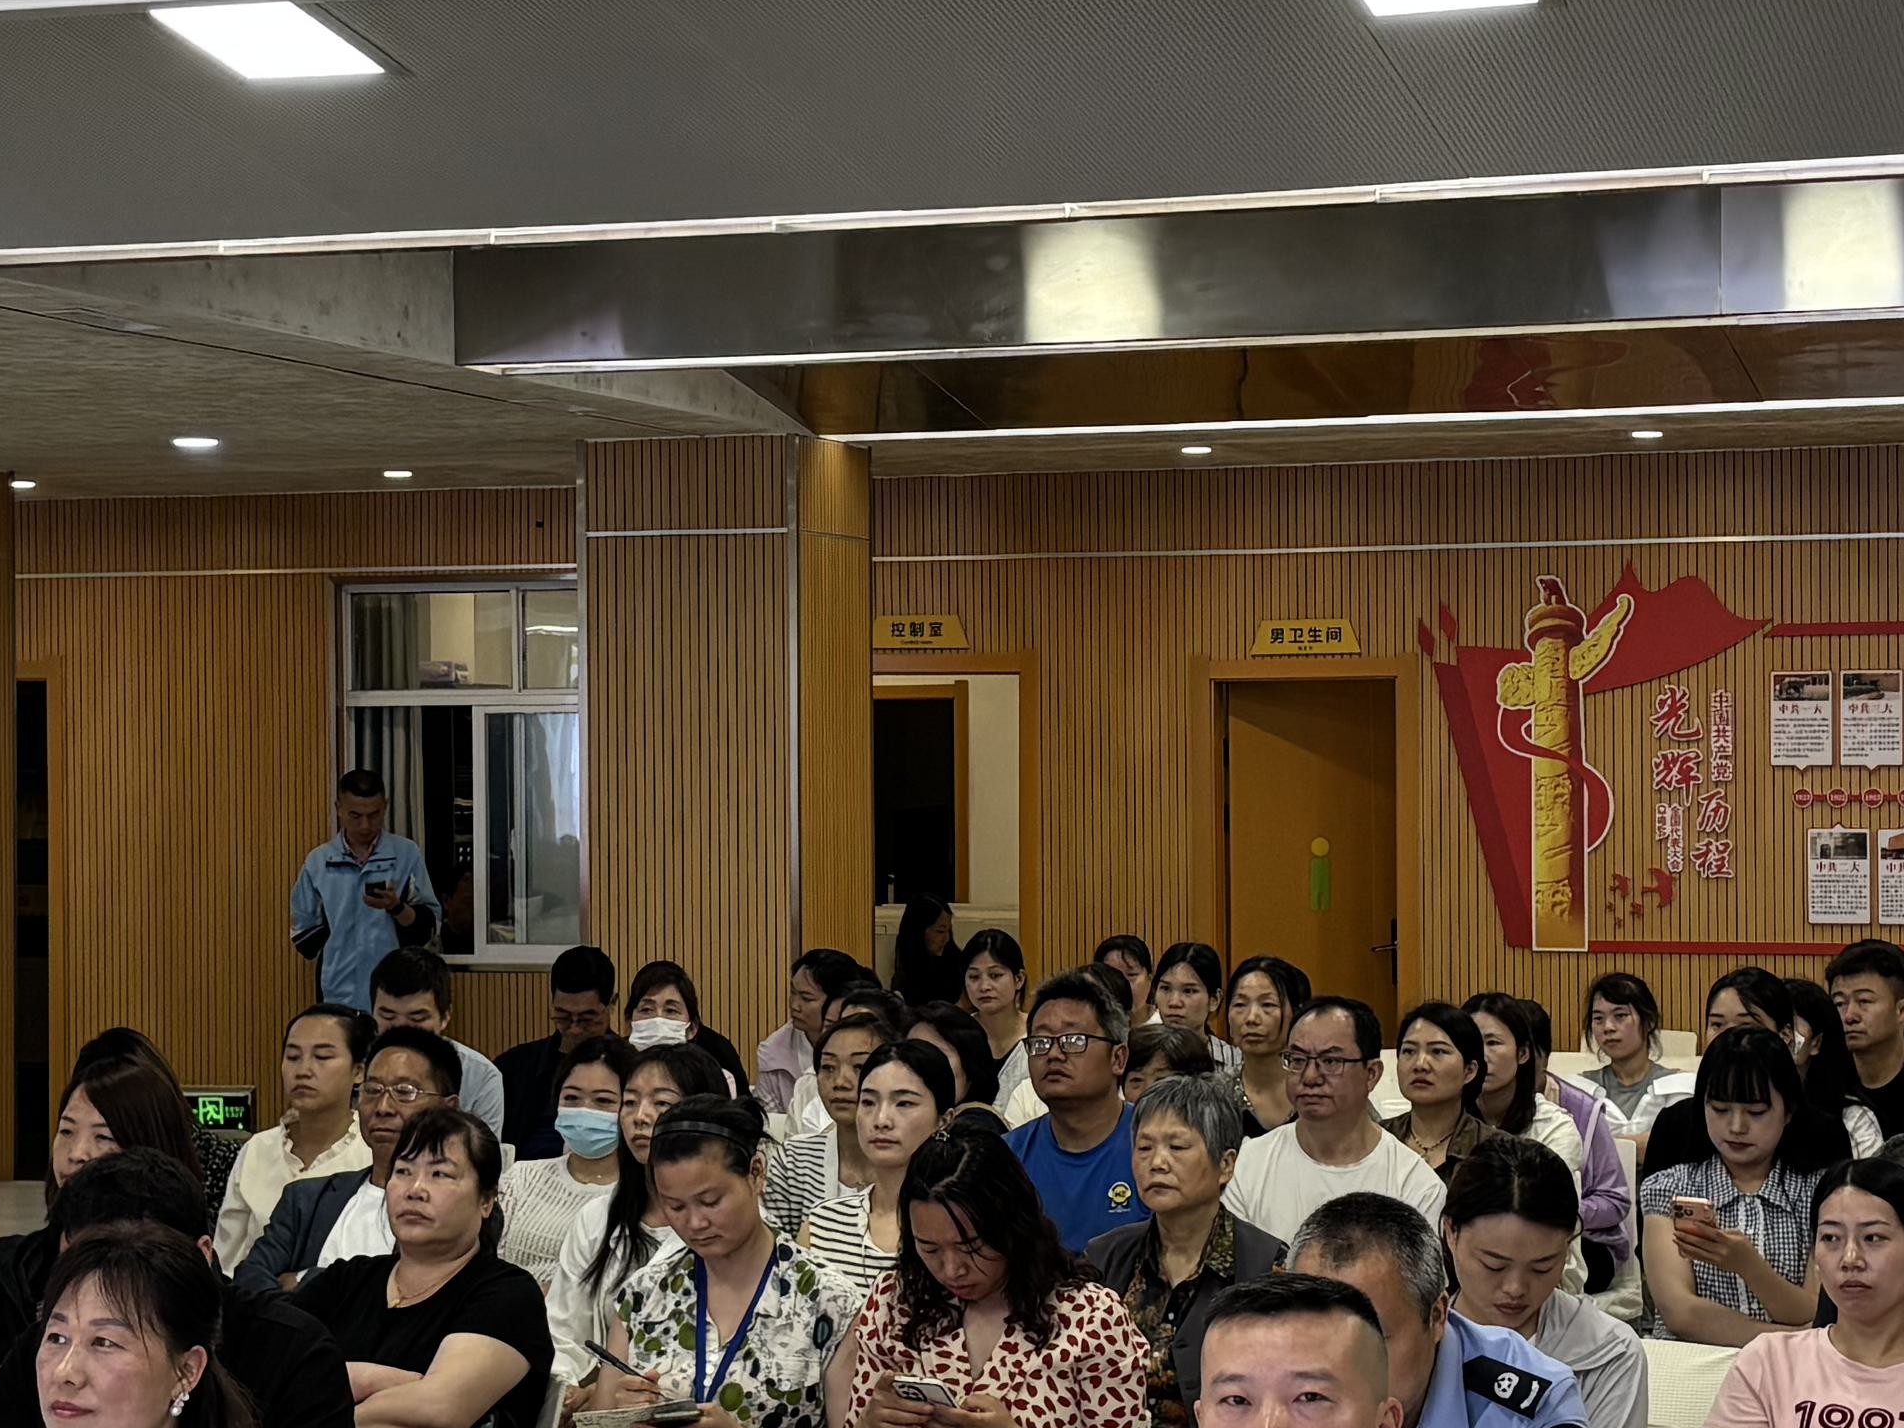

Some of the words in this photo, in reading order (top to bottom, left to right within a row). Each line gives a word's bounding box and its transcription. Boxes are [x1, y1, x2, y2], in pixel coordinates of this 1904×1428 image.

[891, 621, 944, 638] 控制室
[1270, 626, 1342, 644] 男卫生间
[1711, 689, 1733, 782] 中国共产党
